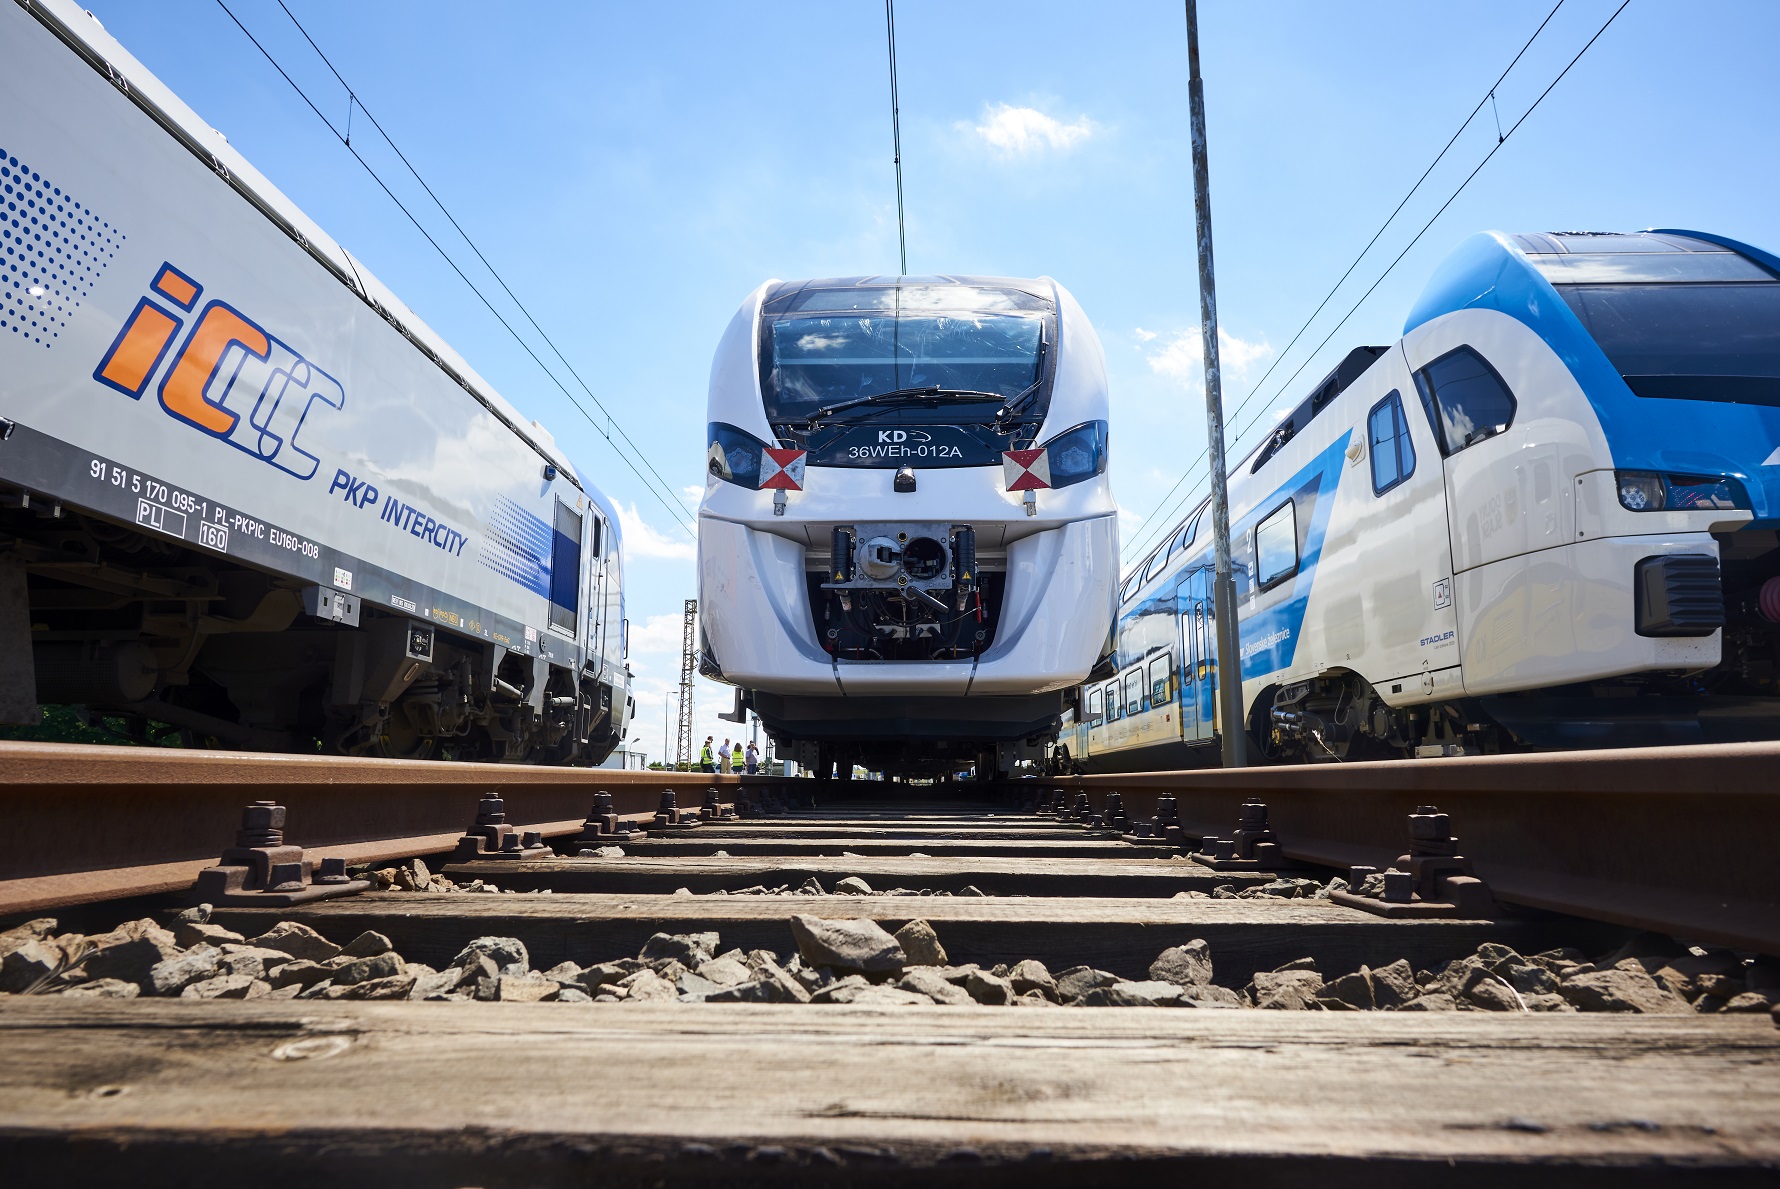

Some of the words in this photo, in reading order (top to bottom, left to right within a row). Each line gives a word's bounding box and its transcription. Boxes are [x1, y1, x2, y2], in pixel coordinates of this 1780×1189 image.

[878, 430, 908, 443] KD
[848, 445, 963, 458] 36WEh-012A
[90, 459, 107, 481] 91
[111, 466, 127, 489] 51
[131, 474, 141, 493] 5
[146, 480, 168, 503] 170
[172, 491, 207, 519] 095-1
[214, 506, 265, 539] PL-PKPIC
[269, 528, 319, 559] EU160-008
[139, 502, 160, 528] PL
[328, 468, 379, 510] PKP
[380, 495, 469, 557] INTERCITY
[202, 525, 226, 549] 160
[1246, 528, 1253, 554] 2
[1420, 630, 1455, 647] STADLER
